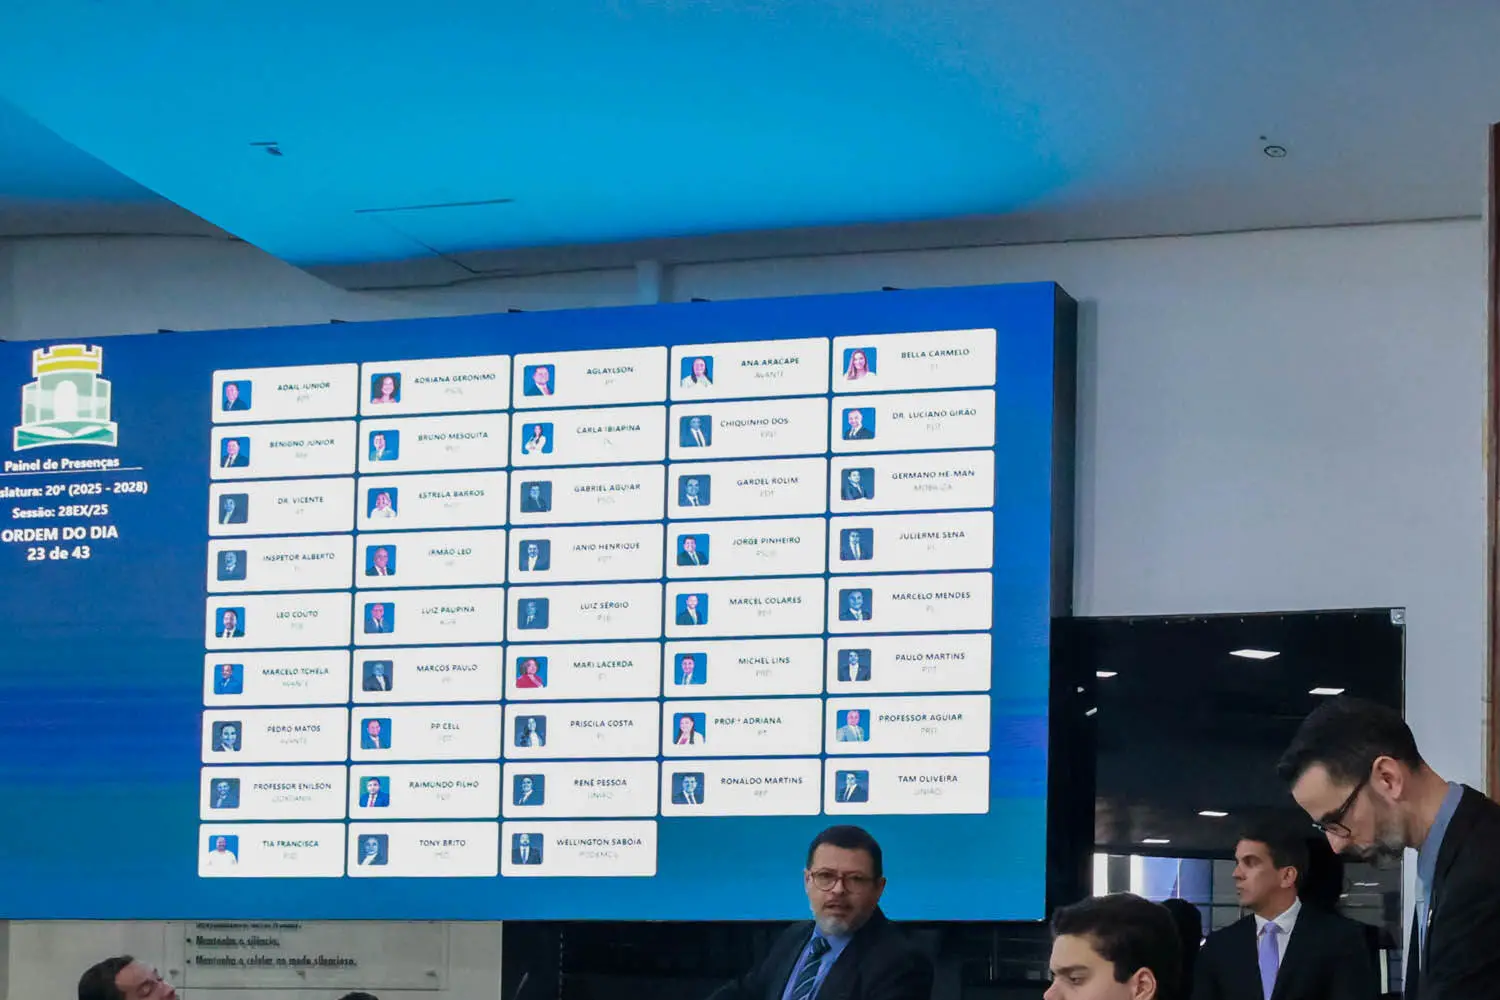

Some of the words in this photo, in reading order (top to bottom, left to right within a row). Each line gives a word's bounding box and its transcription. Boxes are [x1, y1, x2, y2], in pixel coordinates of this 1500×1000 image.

[4, 459, 41, 472] Painel
[42, 458, 59, 469] de
[61, 457, 120, 470] Presenças
[68, 483, 103, 497] (2025
[113, 481, 149, 494] 2028)
[12, 507, 56, 519] Sessão:
[58, 504, 109, 517] 28EX/25
[1, 527, 59, 542] ORDEM
[62, 526, 87, 540] DO
[90, 525, 119, 539] DIA
[27, 547, 45, 561] 23
[49, 546, 69, 560] de
[71, 545, 91, 559] 43
